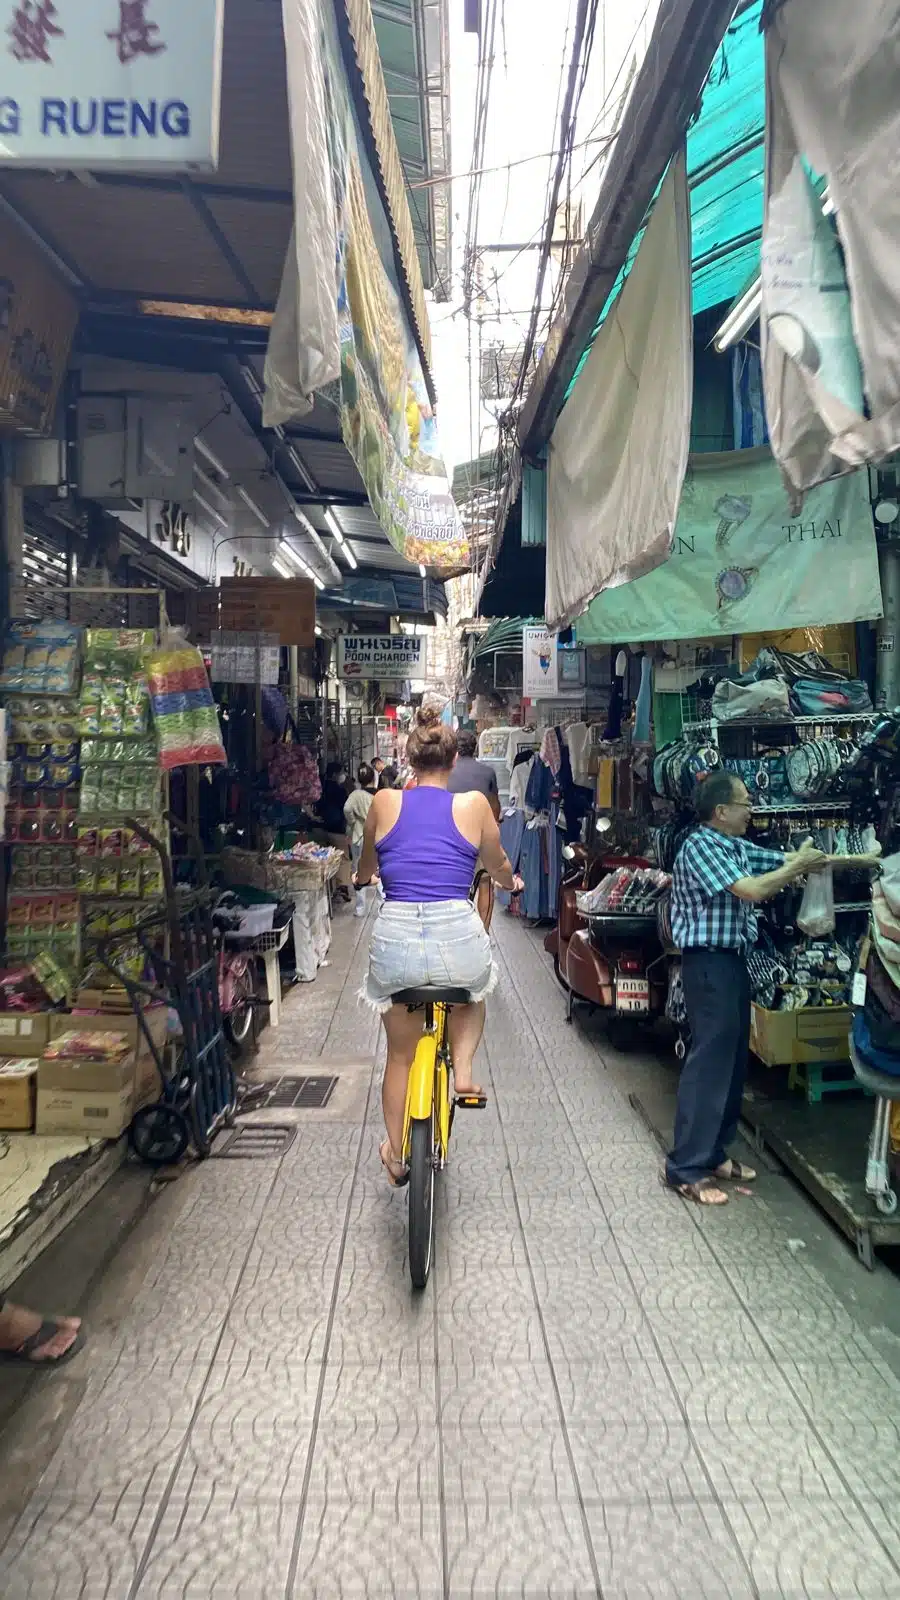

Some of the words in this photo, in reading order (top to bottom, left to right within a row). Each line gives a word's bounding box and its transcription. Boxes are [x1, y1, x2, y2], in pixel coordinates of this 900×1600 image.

[41, 97, 191, 137] RUENG
[781, 519, 844, 543] THAI
[344, 652, 370, 662] POON
[374, 652, 420, 662] CHAROEN
